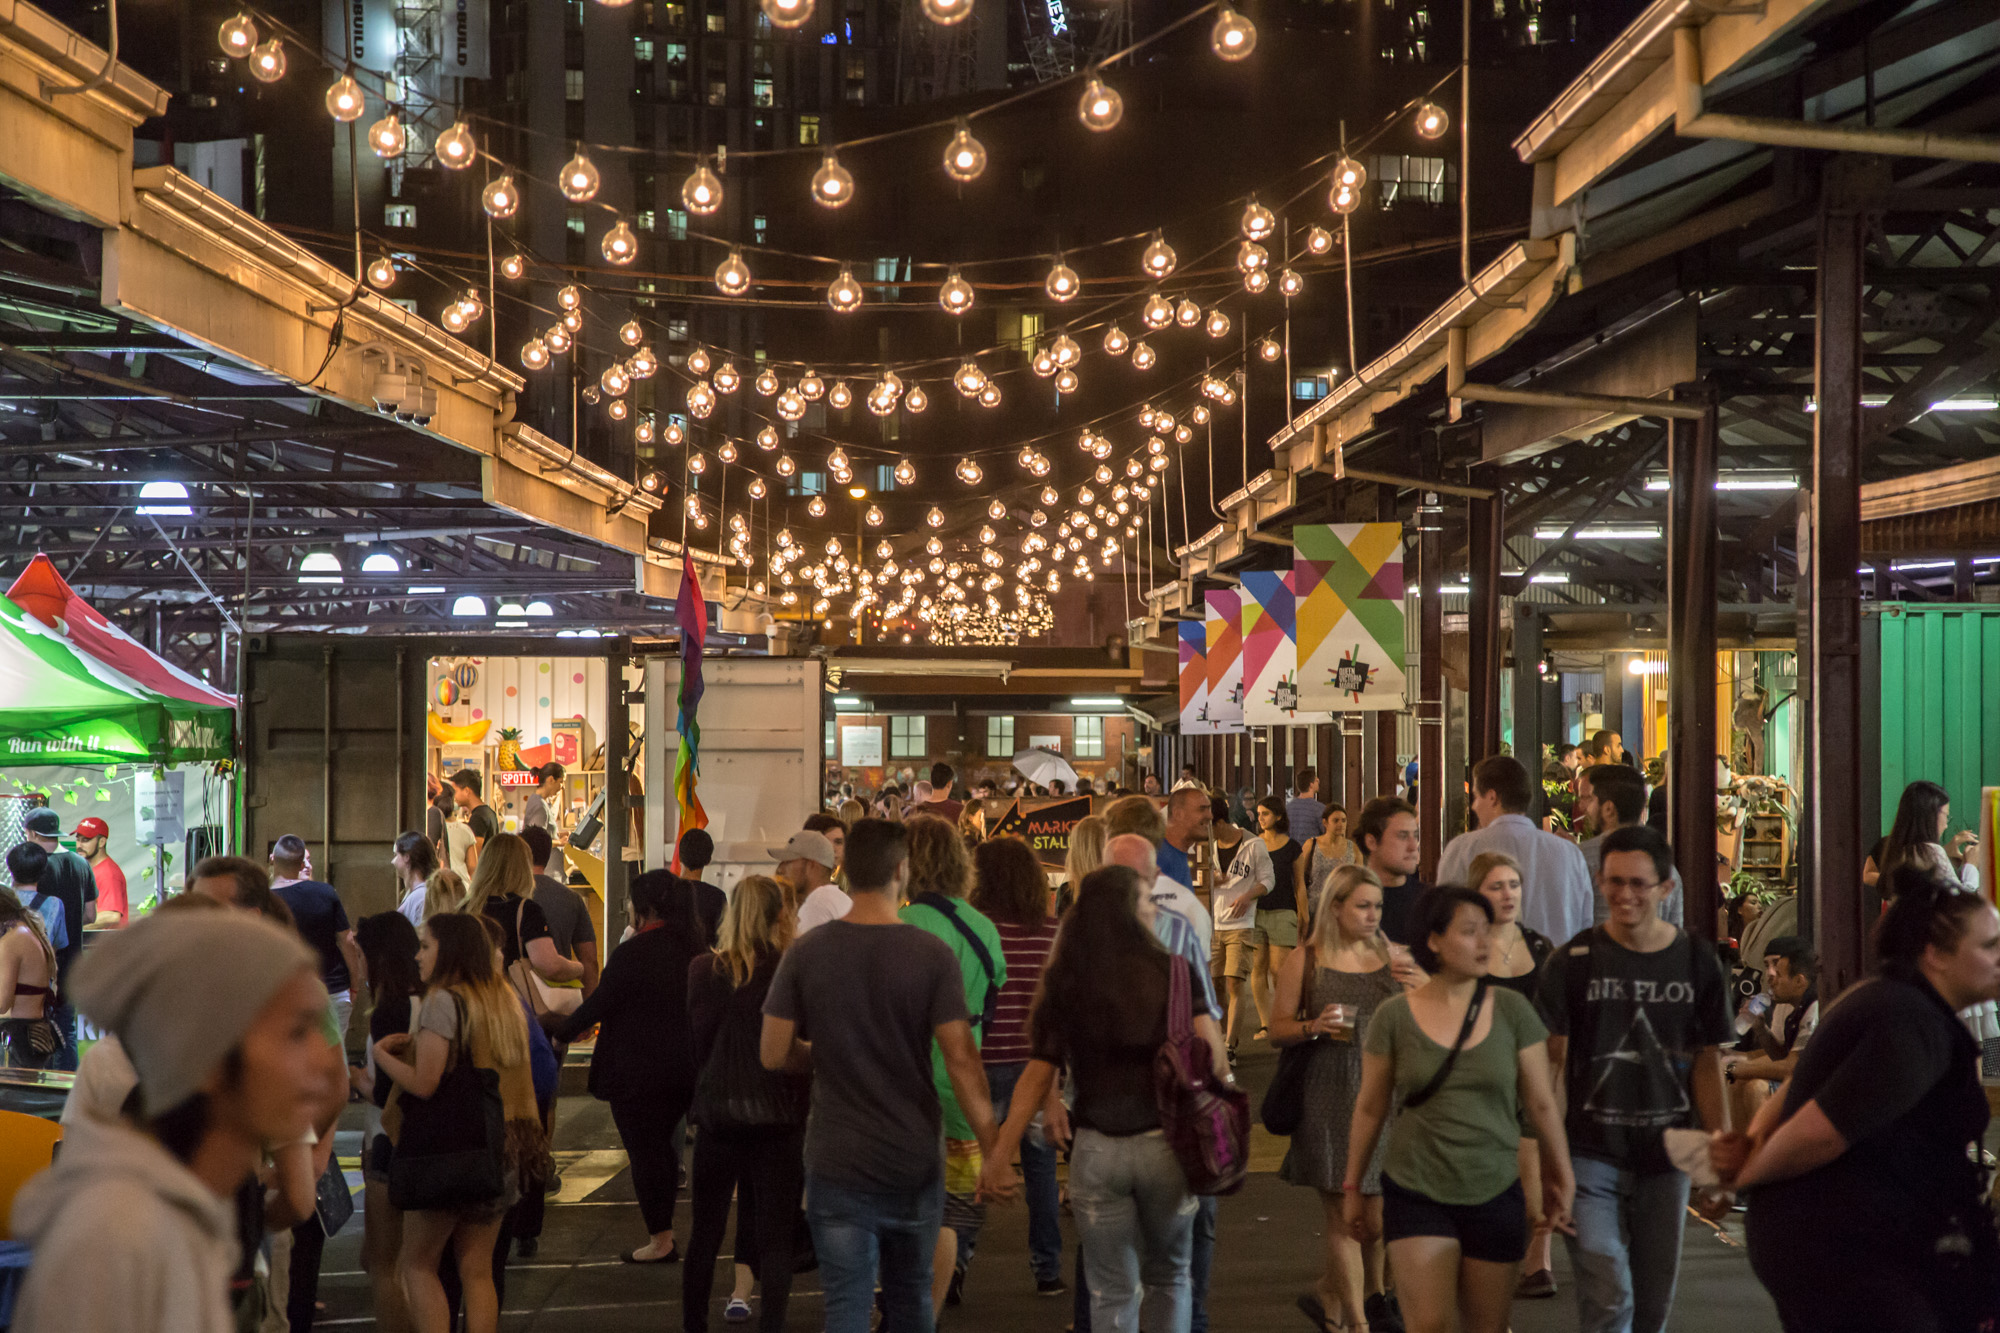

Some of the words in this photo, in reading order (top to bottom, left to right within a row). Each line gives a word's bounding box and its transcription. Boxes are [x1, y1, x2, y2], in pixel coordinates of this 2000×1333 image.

[1046, 0, 1068, 36] EX
[353, 0, 364, 59] BUILD
[7, 737, 42, 753] Run
[46, 736, 82, 752] with
[503, 773, 534, 784] SPOTTY
[1027, 820, 1080, 834] MARKE
